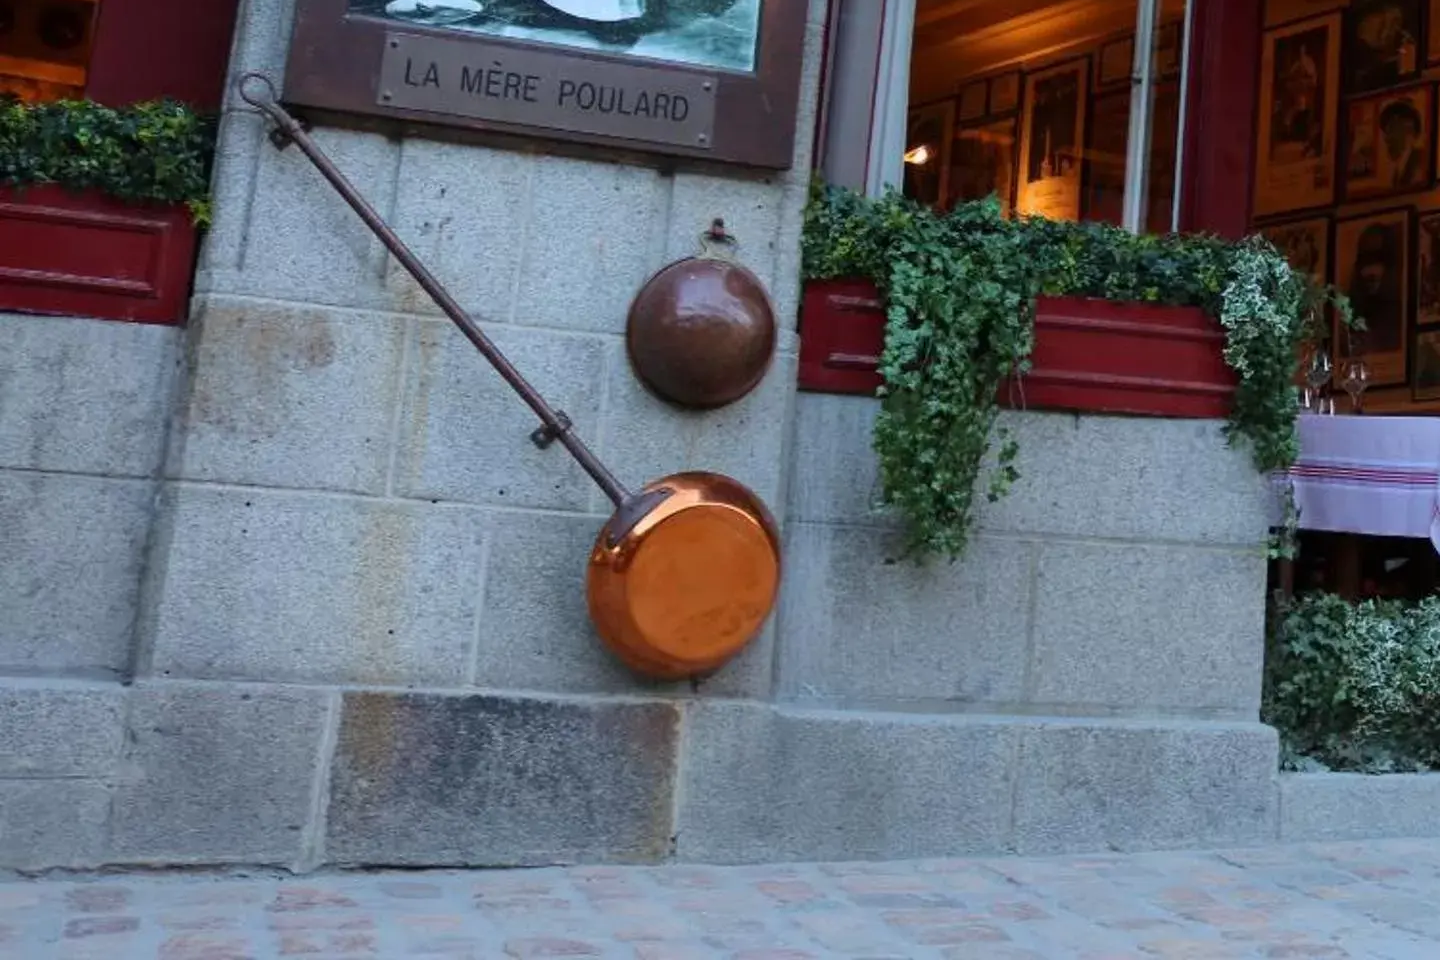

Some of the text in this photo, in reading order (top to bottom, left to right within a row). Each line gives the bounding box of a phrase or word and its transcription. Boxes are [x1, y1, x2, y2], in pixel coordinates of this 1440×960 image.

[404, 58, 690, 123] LA MÈRE POULARD
